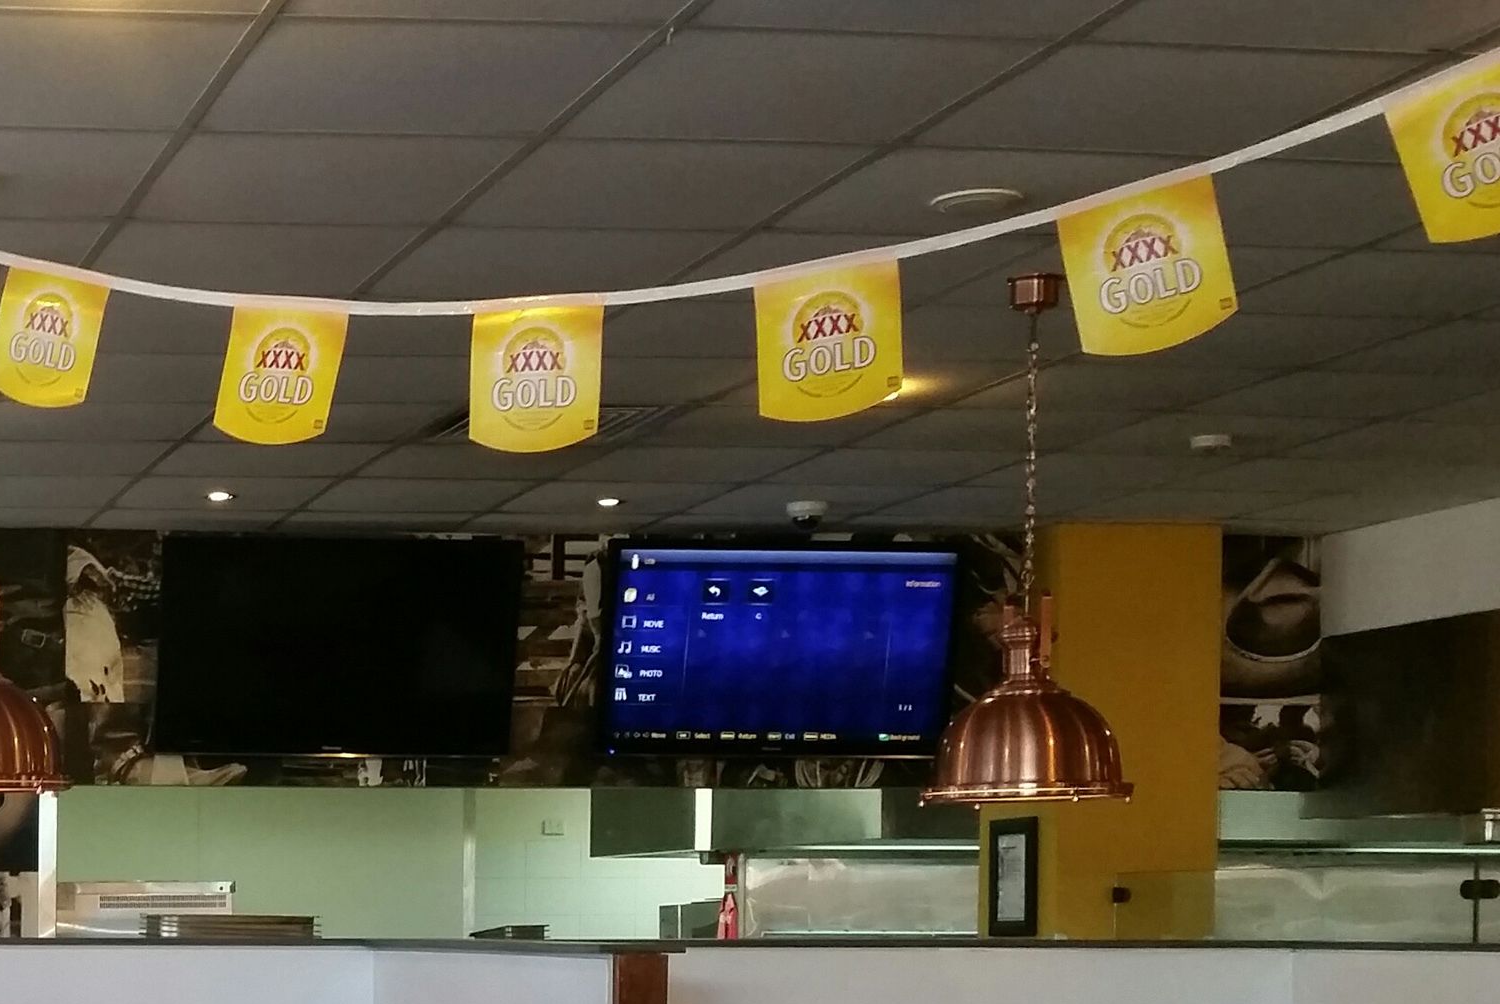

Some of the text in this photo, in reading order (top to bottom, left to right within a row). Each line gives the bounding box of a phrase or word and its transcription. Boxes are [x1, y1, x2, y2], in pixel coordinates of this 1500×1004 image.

[1110, 234, 1179, 273] XXXX
[1100, 257, 1203, 314] GOLD
[25, 312, 69, 337] XXXX
[797, 313, 859, 343] XXXX
[9, 330, 77, 373] GOLD
[255, 349, 306, 371] XXXX
[506, 350, 563, 374] XXXX
[781, 335, 877, 382] GOLD
[237, 370, 315, 406] GOLD
[491, 375, 577, 412] GOLD
[643, 620, 664, 628] MOVIE
[640, 645, 661, 653] MUSIC
[639, 669, 663, 678] PHOTO
[638, 693, 656, 702] TEXT
